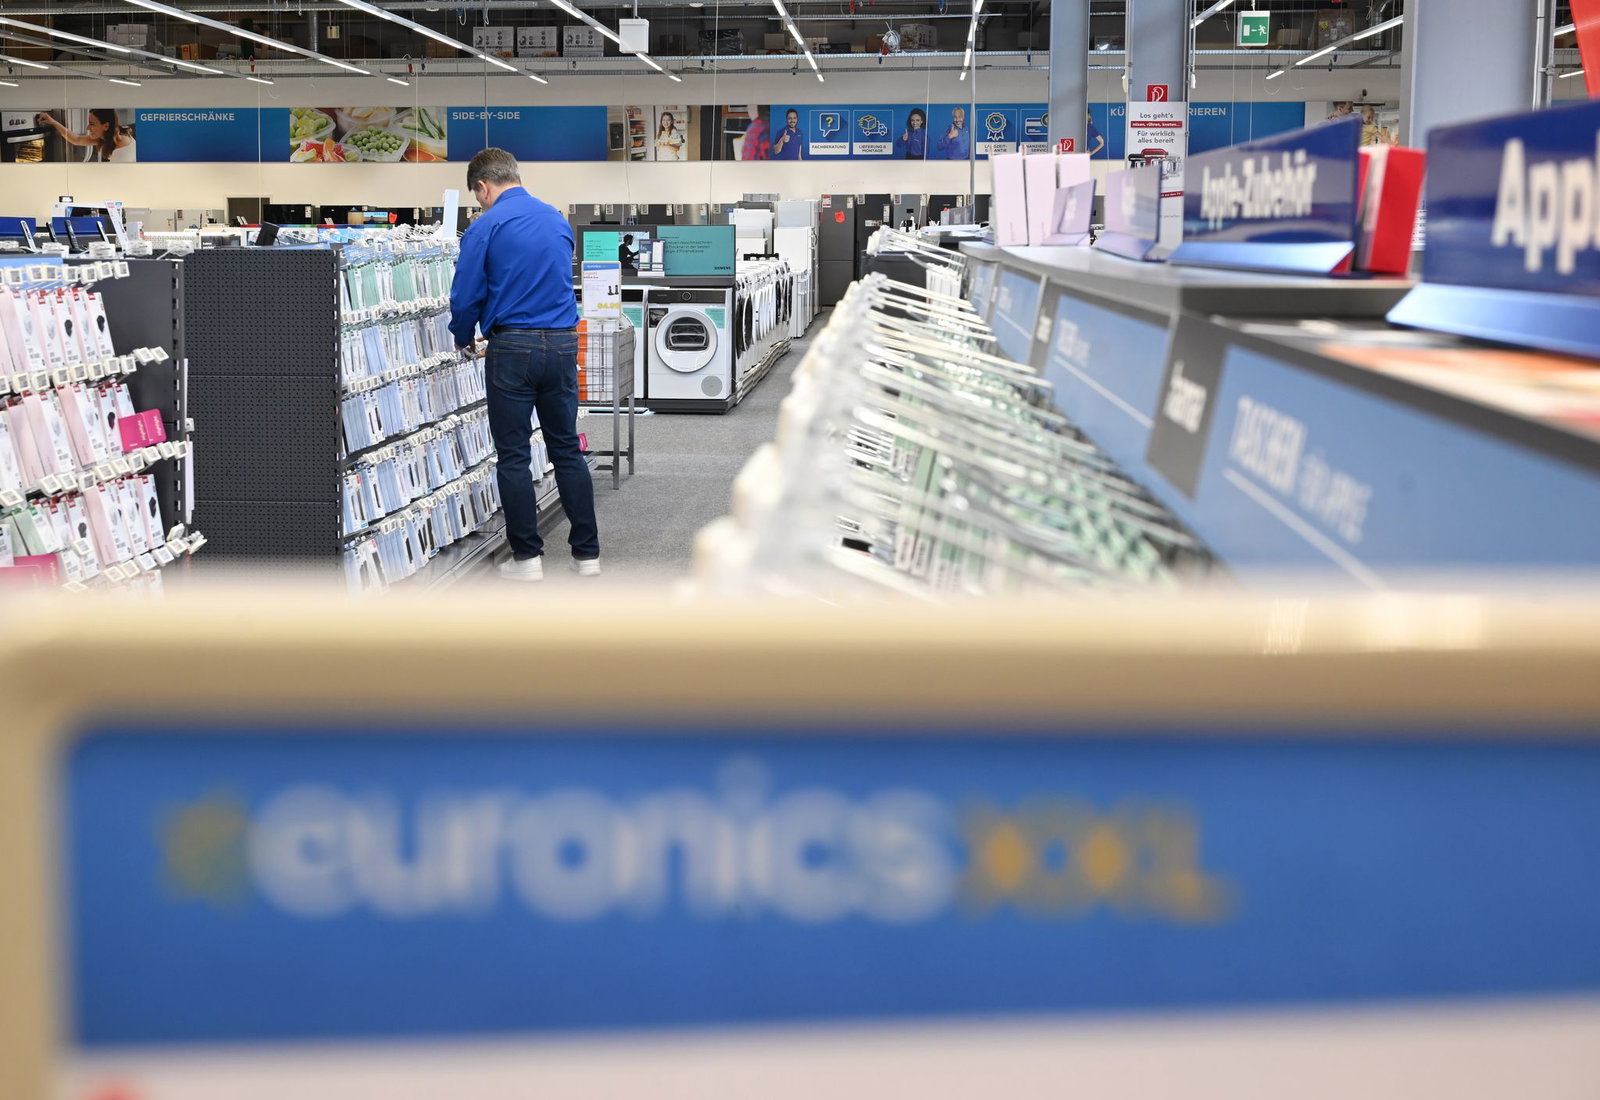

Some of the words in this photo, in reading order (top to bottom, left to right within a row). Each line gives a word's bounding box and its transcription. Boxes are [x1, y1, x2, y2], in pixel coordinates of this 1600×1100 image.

[140, 111, 235, 122] GEFRIERSCHRÄNKE
[452, 111, 520, 120] SIDE-BY-SIDE
[1152, 112, 1174, 120] geht's
[1200, 149, 1317, 231] Apple-Zubehör
